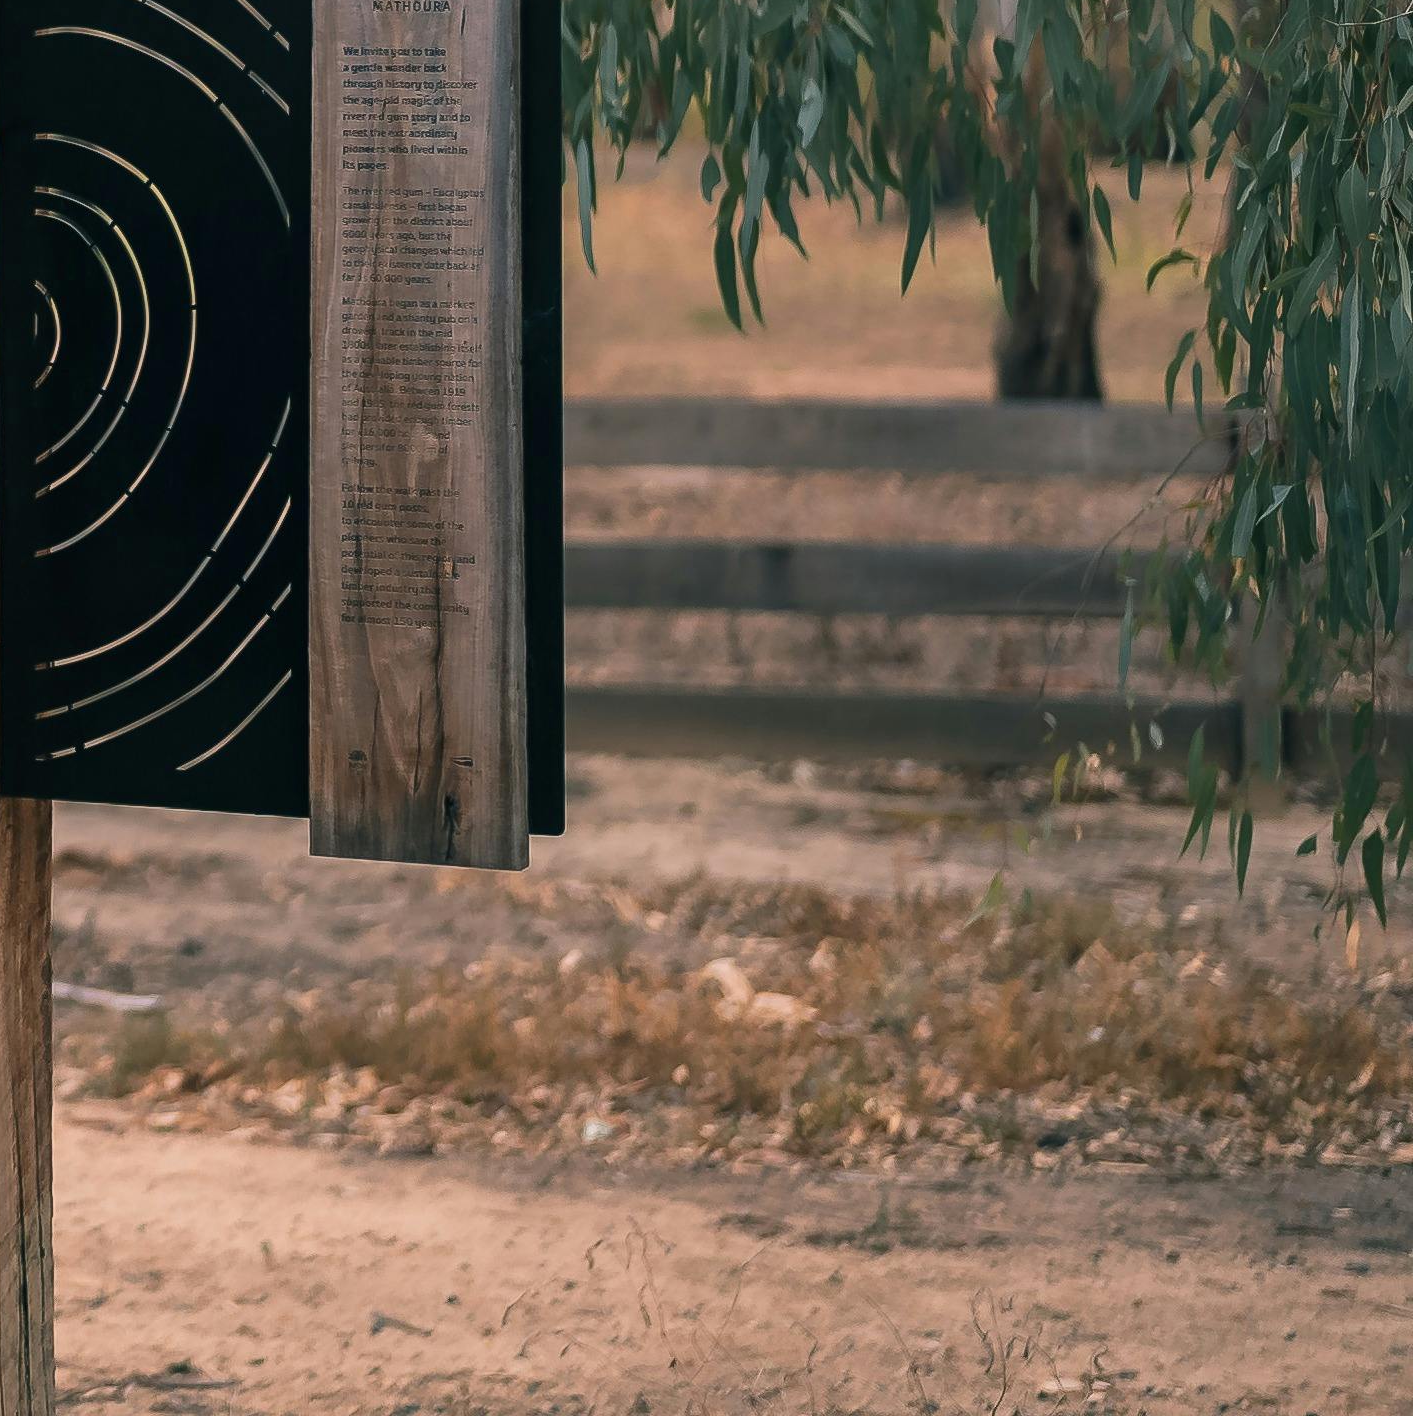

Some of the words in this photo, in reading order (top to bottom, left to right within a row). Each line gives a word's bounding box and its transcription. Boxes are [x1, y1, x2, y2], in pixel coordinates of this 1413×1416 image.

[373, 0, 450, 12] MATHOURA
[343, 47, 359, 56] We
[360, 47, 389, 56] invite
[390, 49, 410, 58] you
[425, 47, 446, 56] take
[351, 64, 383, 74] gentle
[385, 64, 422, 73] wander
[423, 64, 446, 73] back
[343, 79, 383, 90] through
[385, 80, 421, 91] history
[435, 80, 477, 89] discover
[343, 95, 360, 104] the
[402, 96, 432, 107] magic
[343, 113, 367, 122] river
[368, 113, 384, 122] red
[387, 115, 409, 123] gum
[439, 113, 458, 122] and
[343, 129, 367, 137] meet
[370, 129, 386, 137] the
[343, 145, 385, 155] pioneers
[388, 146, 409, 154] who
[411, 146, 434, 154] lived
[437, 146, 468, 154] within
[357, 161, 390, 172] pages.
[342, 187, 360, 195] The
[403, 190, 423, 198] gum
[438, 203, 467, 213] began
[393, 216, 409, 226] the
[410, 216, 444, 226] district
[419, 232, 434, 240] but
[400, 246, 438, 255] changes
[446, 261, 468, 271] back
[437, 315, 456, 324] pub
[420, 585, 441, 595] tha
